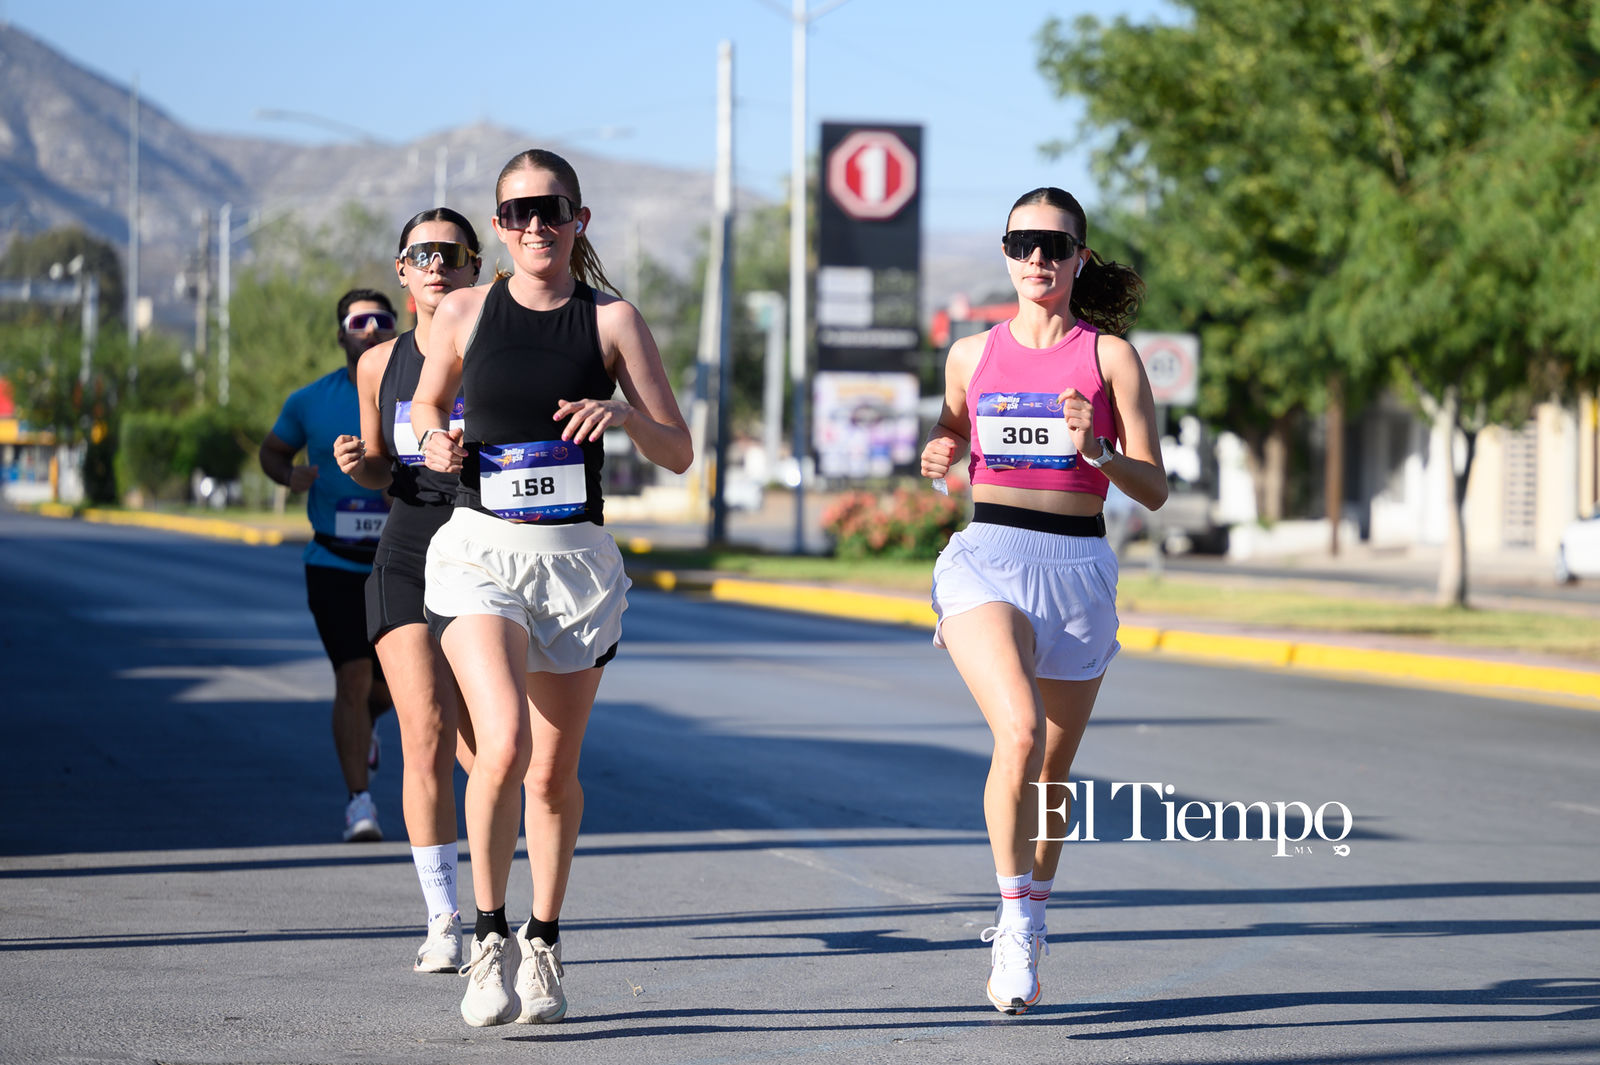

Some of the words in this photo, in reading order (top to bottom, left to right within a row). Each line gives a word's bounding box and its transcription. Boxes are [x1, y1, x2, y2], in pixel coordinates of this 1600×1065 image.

[855, 145, 888, 203] 1
[1002, 427, 1049, 445] 306
[511, 477, 555, 497] 158
